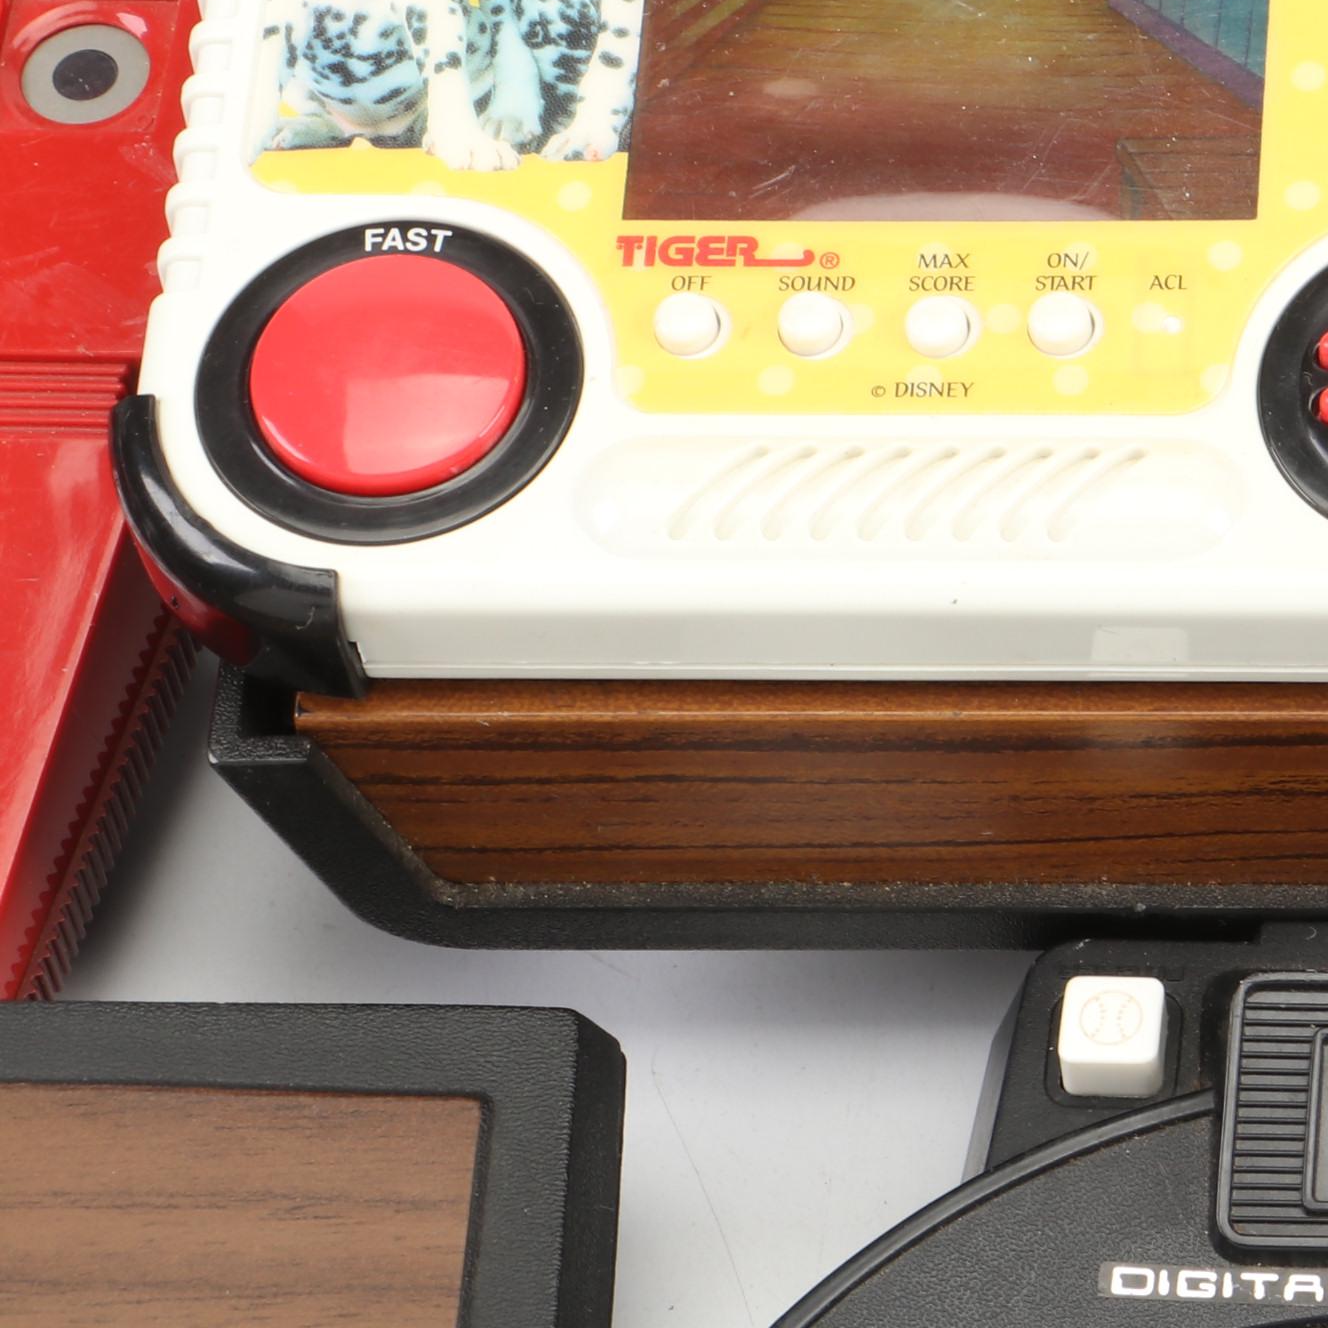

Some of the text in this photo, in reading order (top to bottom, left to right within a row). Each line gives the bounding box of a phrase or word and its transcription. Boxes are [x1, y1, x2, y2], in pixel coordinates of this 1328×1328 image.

[363, 227, 453, 253] FAST
[917, 252, 971, 270] MAX
[1045, 251, 1091, 270] ON/
[670, 274, 713, 292] OFF
[777, 274, 856, 293] SOUND
[907, 274, 976, 293] SCORE
[1034, 274, 1097, 292] START
[1148, 274, 1188, 292] ACL
[892, 380, 976, 399] DISNEY
